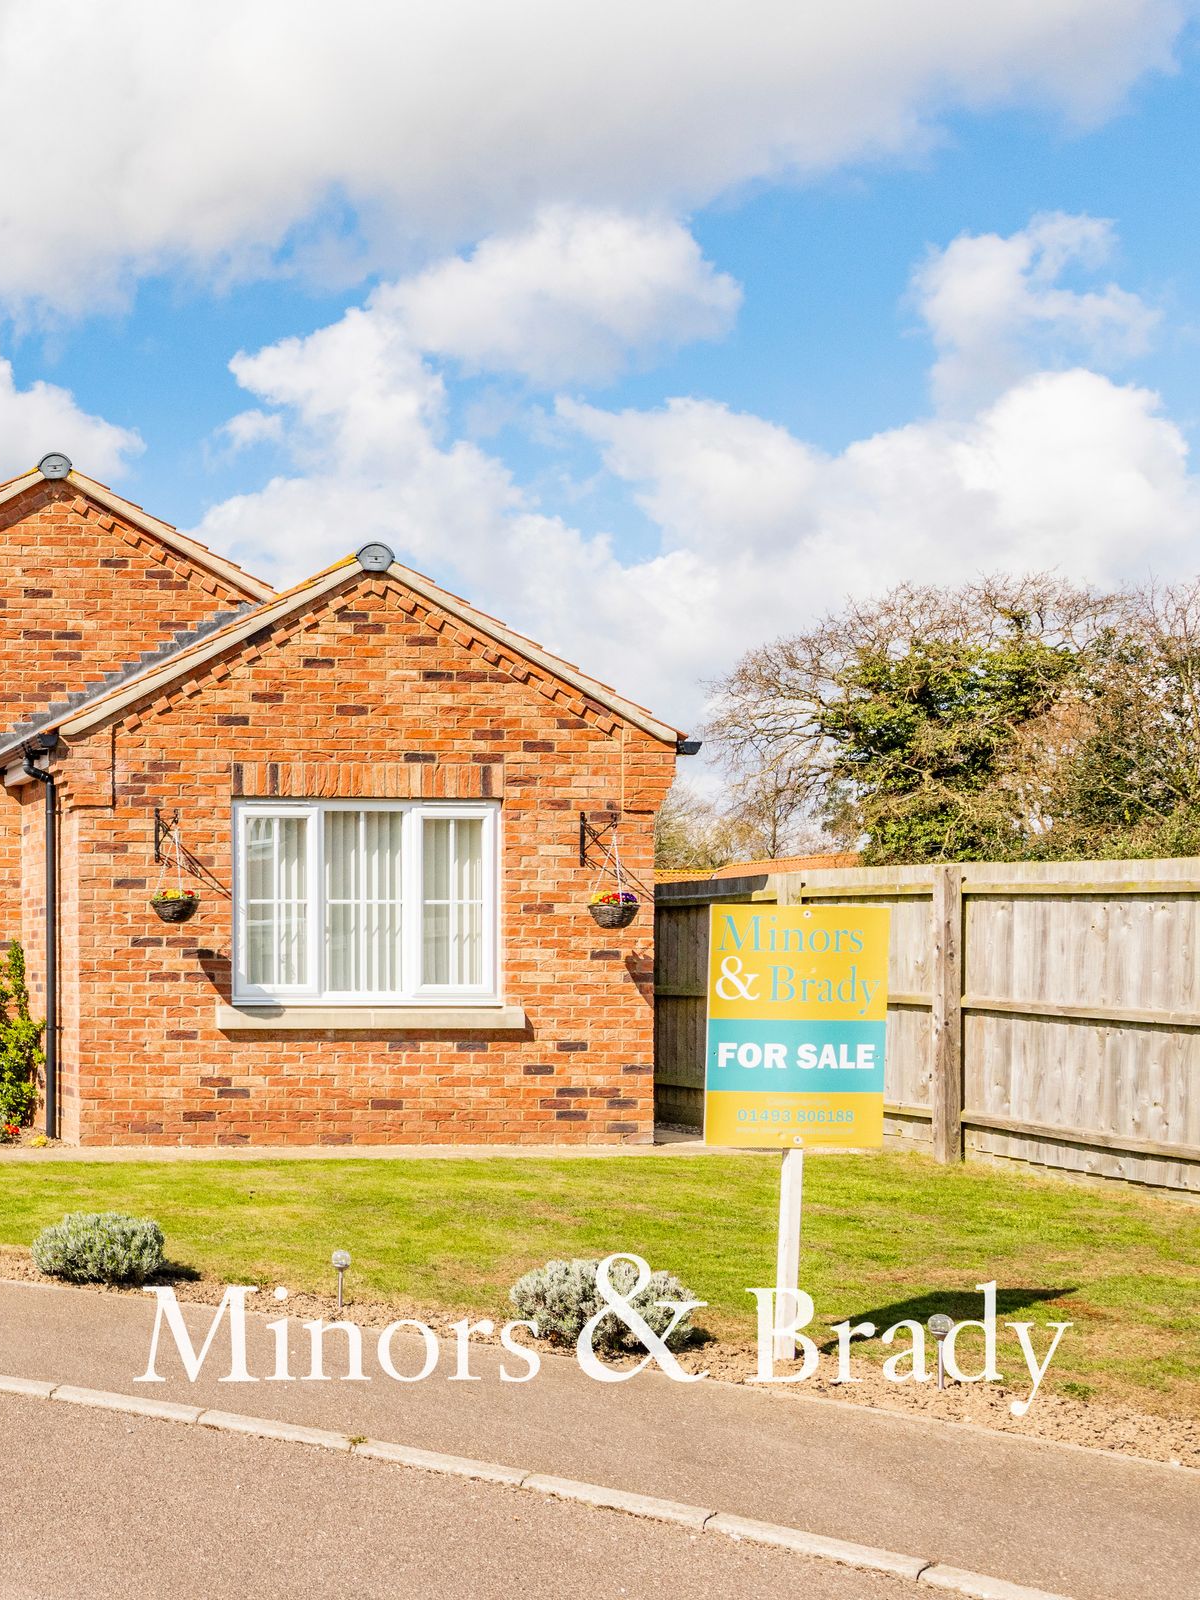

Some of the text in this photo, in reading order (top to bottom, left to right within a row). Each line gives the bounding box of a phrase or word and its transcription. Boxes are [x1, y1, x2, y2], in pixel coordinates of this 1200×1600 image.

[719, 915, 864, 952] Minors
[715, 955, 880, 1015] & Brady
[718, 1042, 875, 1069] FOR SALE
[737, 1109, 855, 1123] 01493 806188
